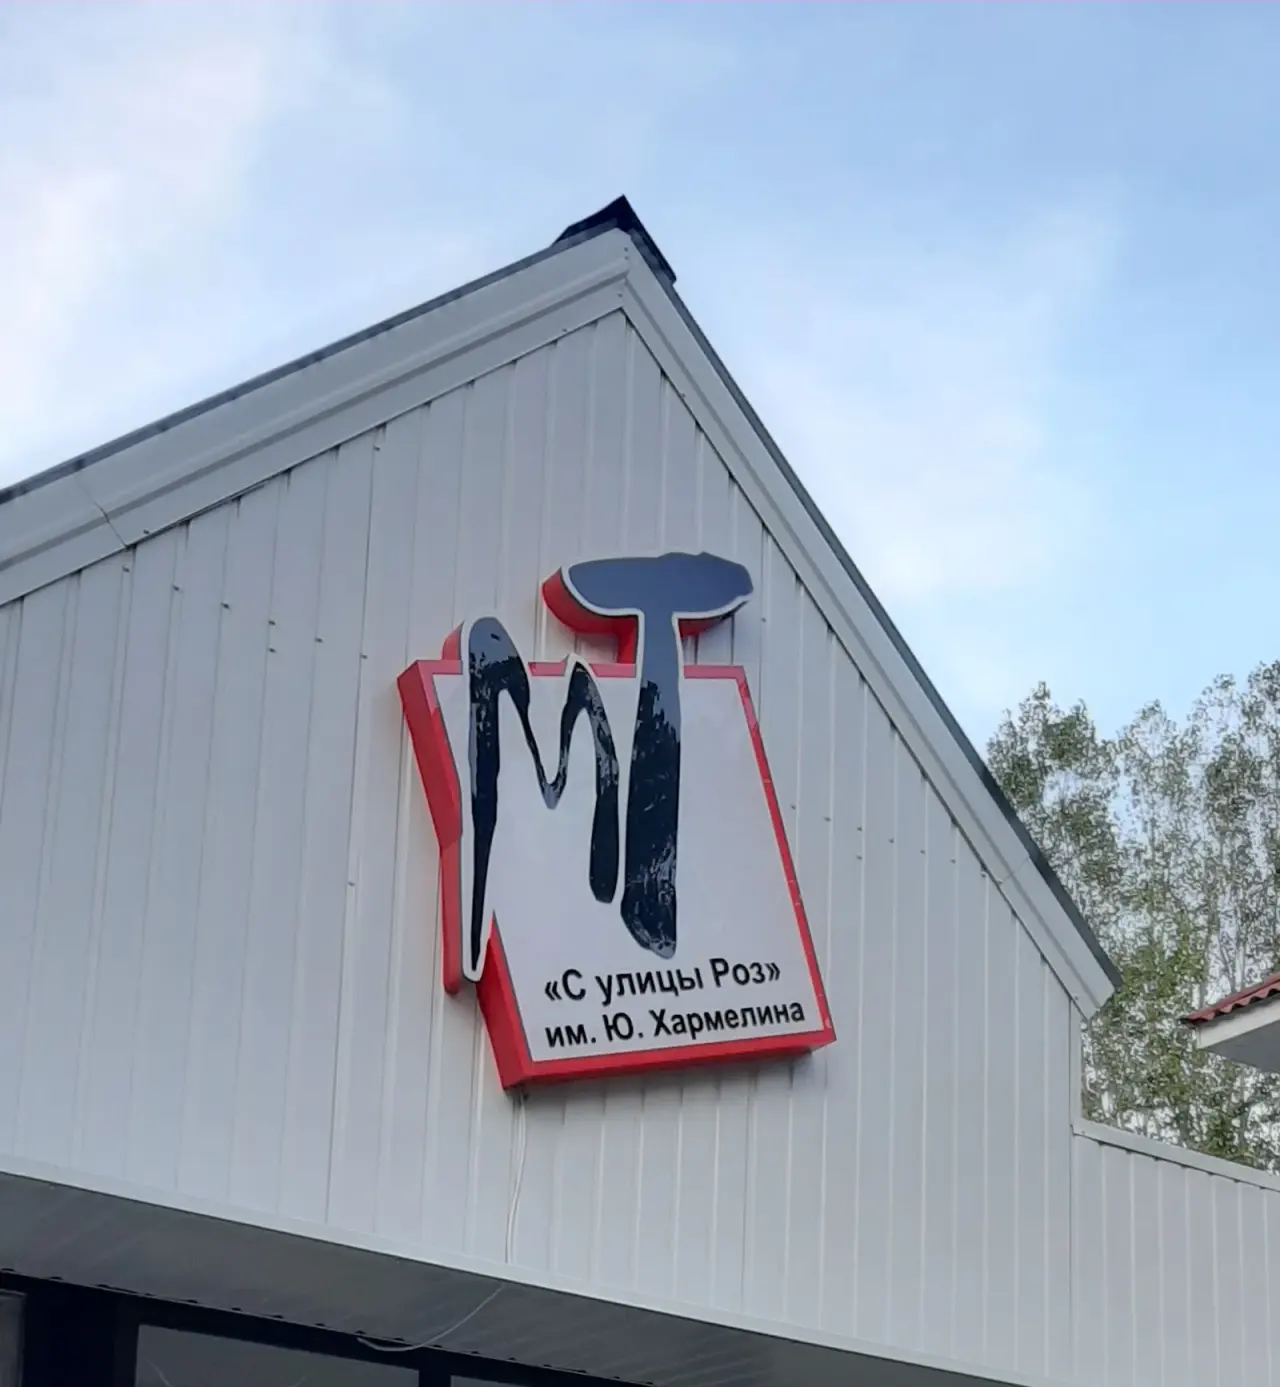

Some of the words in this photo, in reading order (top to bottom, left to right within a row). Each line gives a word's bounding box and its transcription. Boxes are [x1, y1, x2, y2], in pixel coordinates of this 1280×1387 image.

[544, 968, 586, 1002] «С
[595, 967, 704, 1006] улицы
[709, 957, 781, 988] Роз»
[545, 1023, 597, 1048] им.
[602, 1012, 644, 1042] Ю.
[649, 1001, 805, 1039] Хармелина
